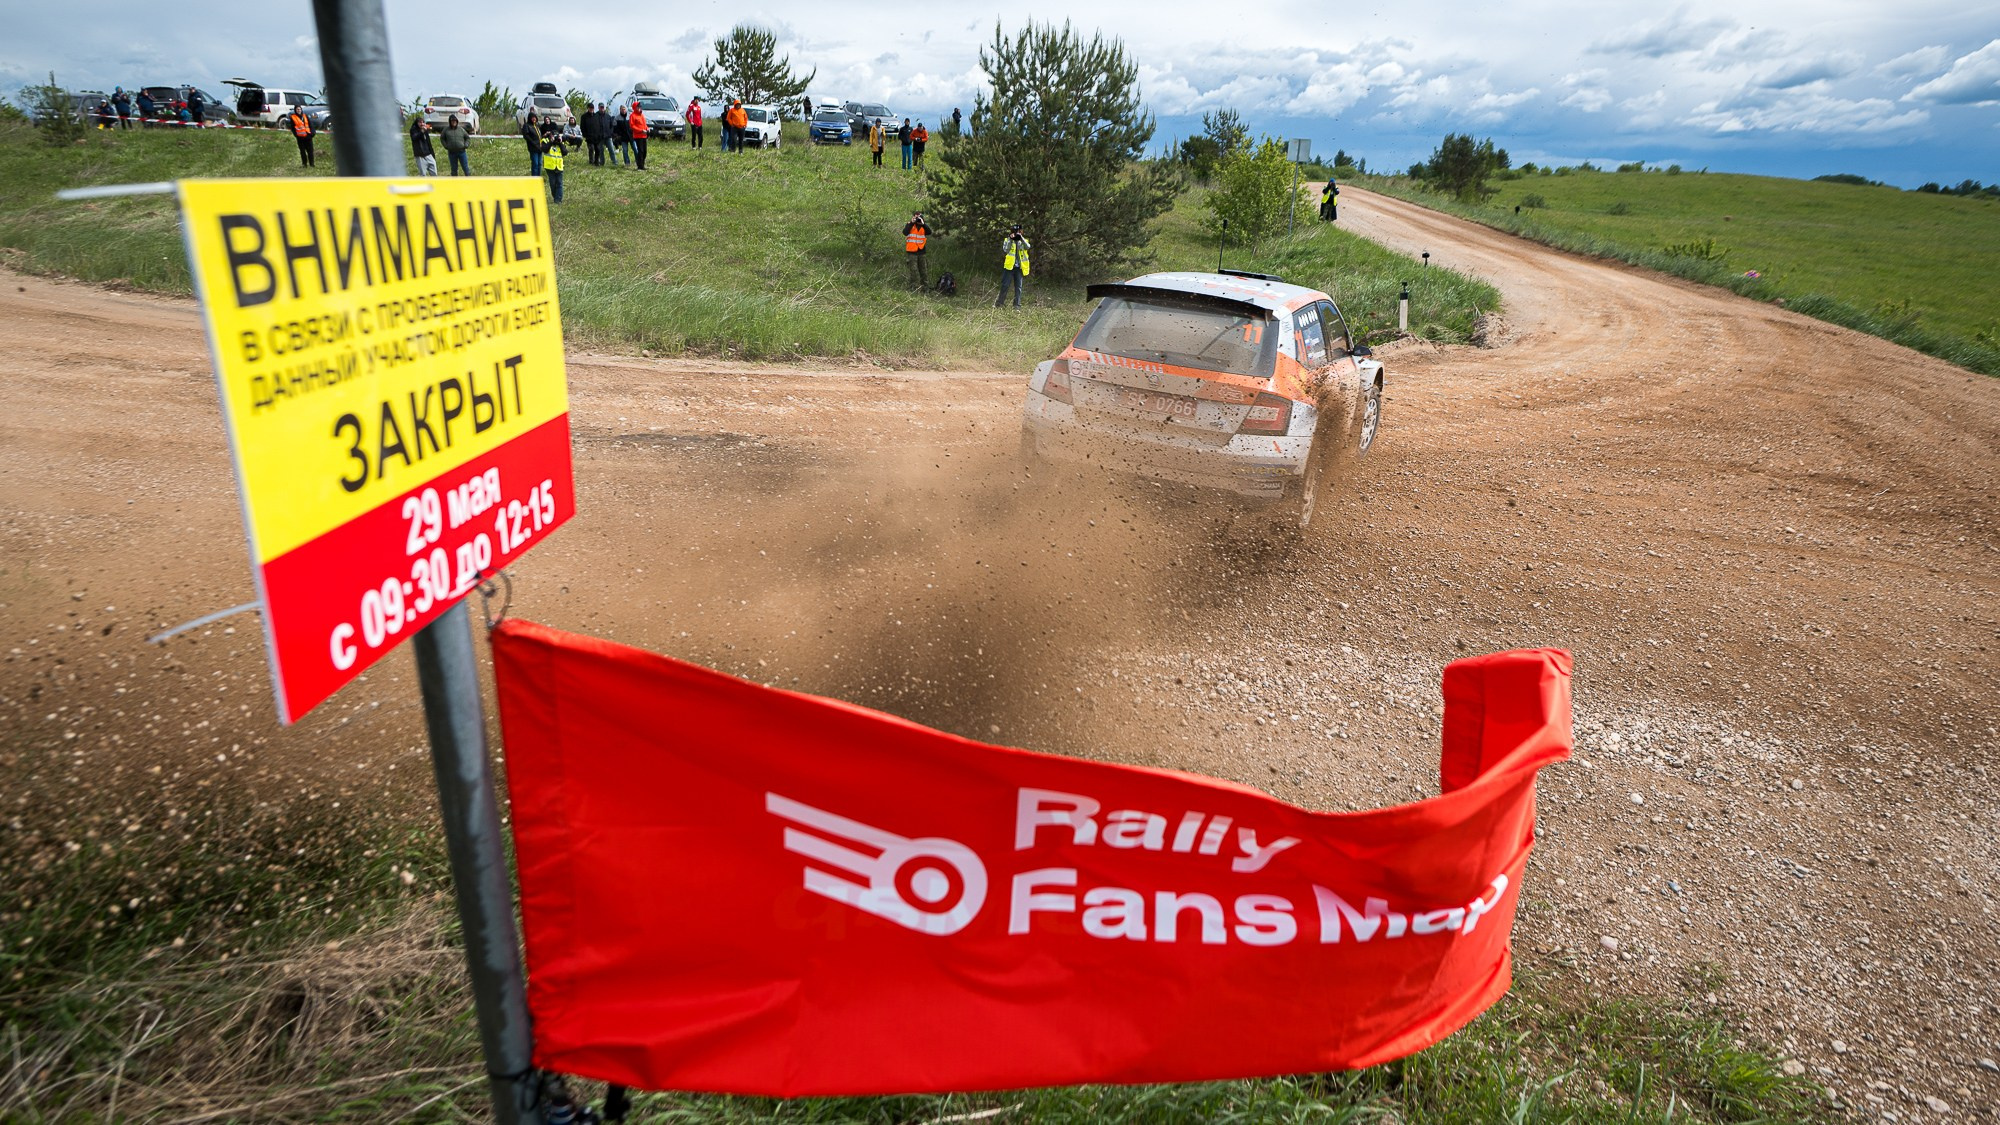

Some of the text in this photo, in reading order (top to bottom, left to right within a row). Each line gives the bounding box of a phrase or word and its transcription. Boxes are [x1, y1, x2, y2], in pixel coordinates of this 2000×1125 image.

[219, 198, 543, 308] ВНИМАНИЕ!
[240, 271, 547, 362] В СВЯЗИ С ПРОВЕДЕНИЕМ РАЛЛИ
[250, 301, 550, 413] ДАННЫЙ УЧАСТОК ДОРОГИ БУДЕТ
[1242, 323, 1263, 345] 11
[333, 354, 523, 493] ЗАКРЫТ
[1156, 396, 1194, 416] 0766
[402, 466, 502, 555] 29 мая
[330, 478, 556, 671] с 09:30 до 12:15
[1014, 787, 1302, 873] Rally
[1008, 867, 1509, 946] Fans Map
